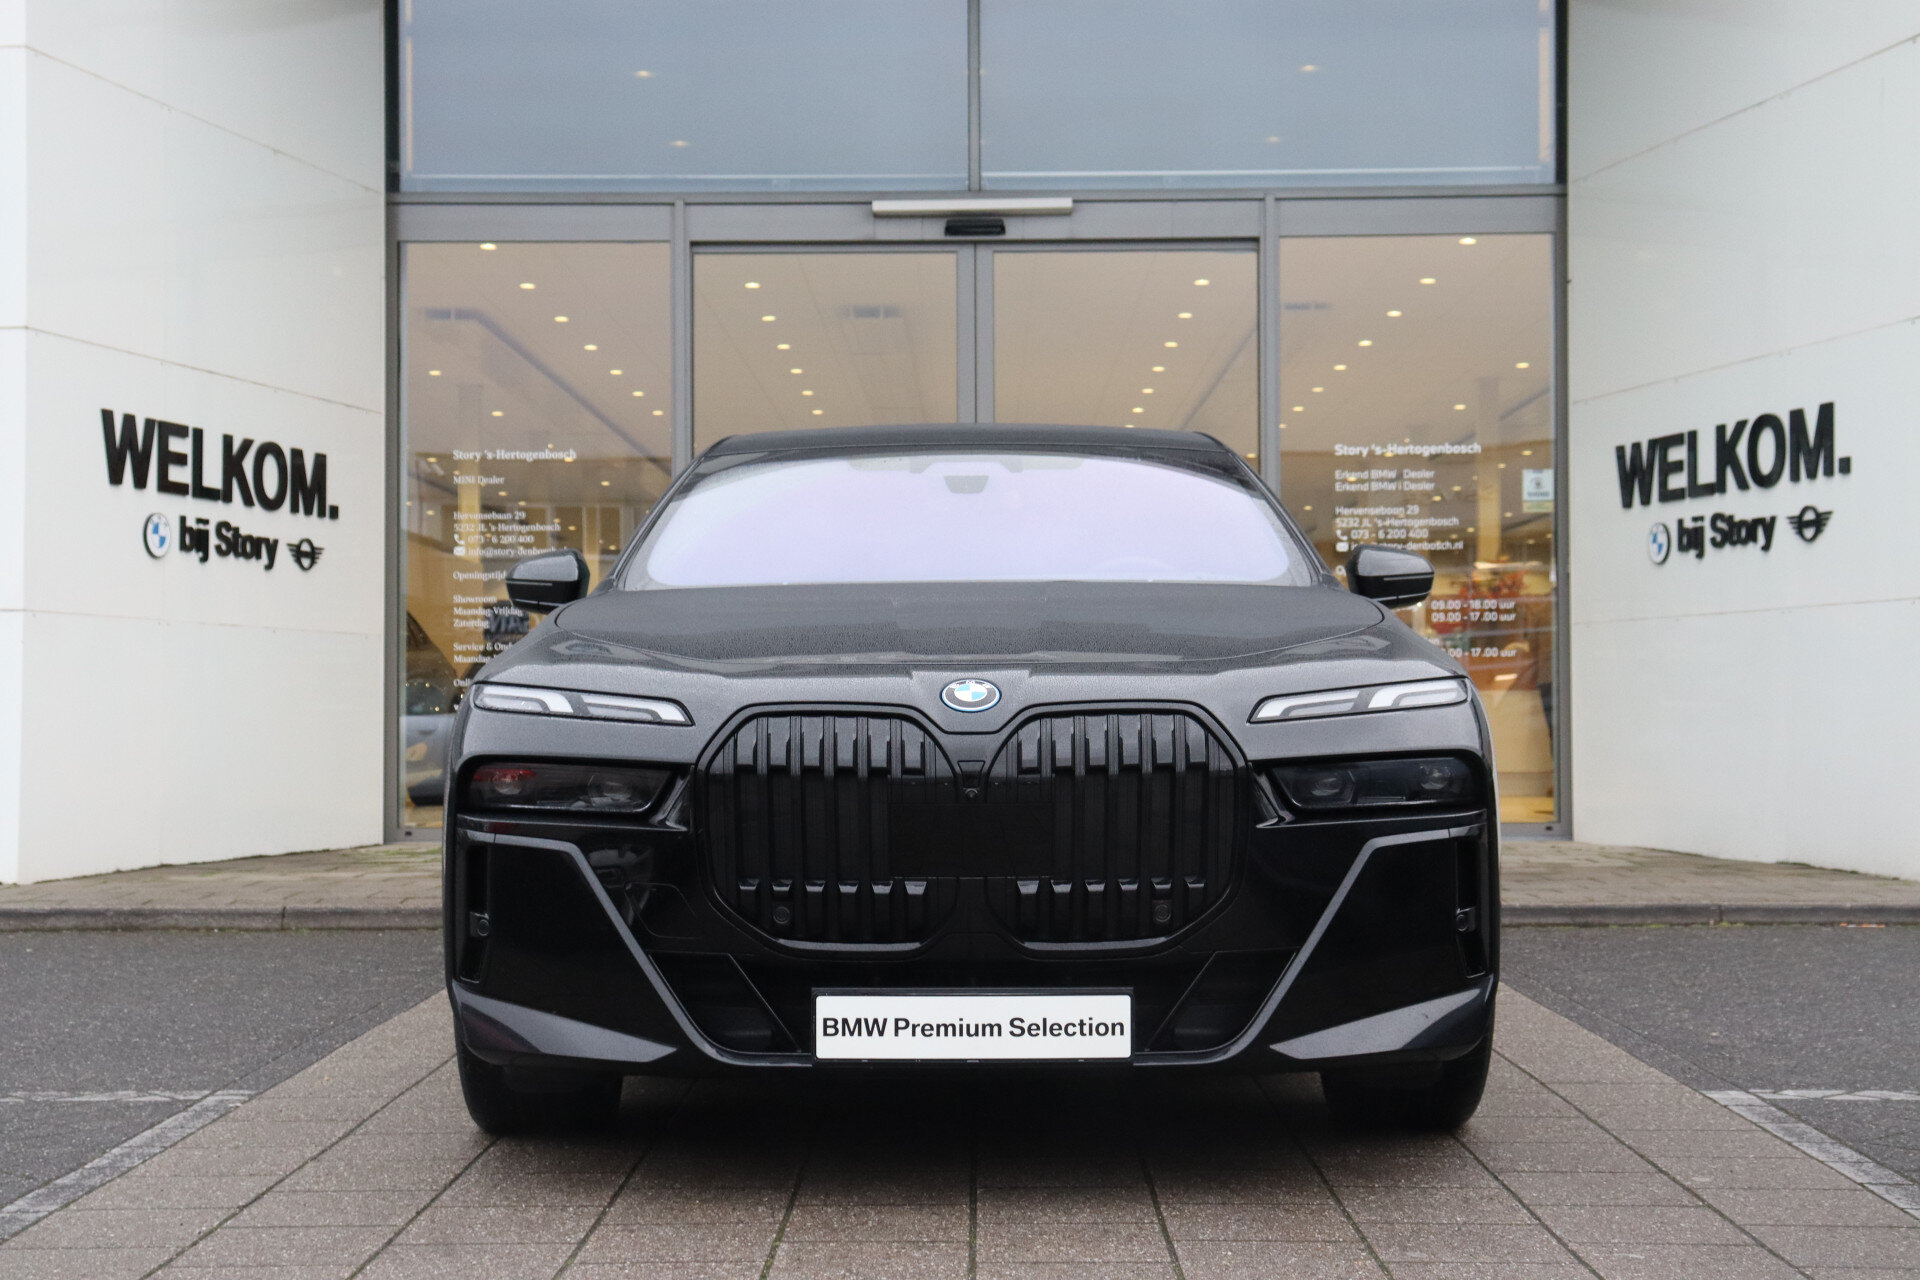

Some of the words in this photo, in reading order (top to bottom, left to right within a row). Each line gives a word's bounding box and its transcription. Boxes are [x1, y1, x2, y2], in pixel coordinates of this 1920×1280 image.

[453, 449, 481, 462] Story
[1334, 443, 1369, 457] Story
[1615, 401, 1852, 509] WELKOM.
[100, 408, 339, 520] WELKOM.
[1370, 469, 1397, 479] BMW
[1403, 468, 1436, 479] Dealer
[1370, 481, 1396, 491] BMW
[1403, 480, 1436, 491] Dealer
[1406, 504, 1420, 515] 29
[514, 511, 527, 520] 29
[1350, 529, 1370, 540] 073
[1377, 529, 1386, 539] 6
[1386, 528, 1407, 539] 200
[1408, 528, 1429, 539] 400
[1676, 515, 1705, 559] bij
[1710, 512, 1777, 552] Story
[178, 515, 210, 563] bij
[214, 520, 279, 571] Story
[453, 594, 498, 603] Showroom
[1430, 600, 1462, 610] 09.00
[1498, 601, 1516, 610] uur
[1430, 612, 1462, 622] 09.00
[1498, 613, 1517, 622] uur
[453, 642, 485, 651] Service
[1500, 649, 1517, 658] uur
[822, 1018, 887, 1037] BMW
[894, 1018, 1002, 1038] Premium
[1009, 1017, 1125, 1037] Selection
